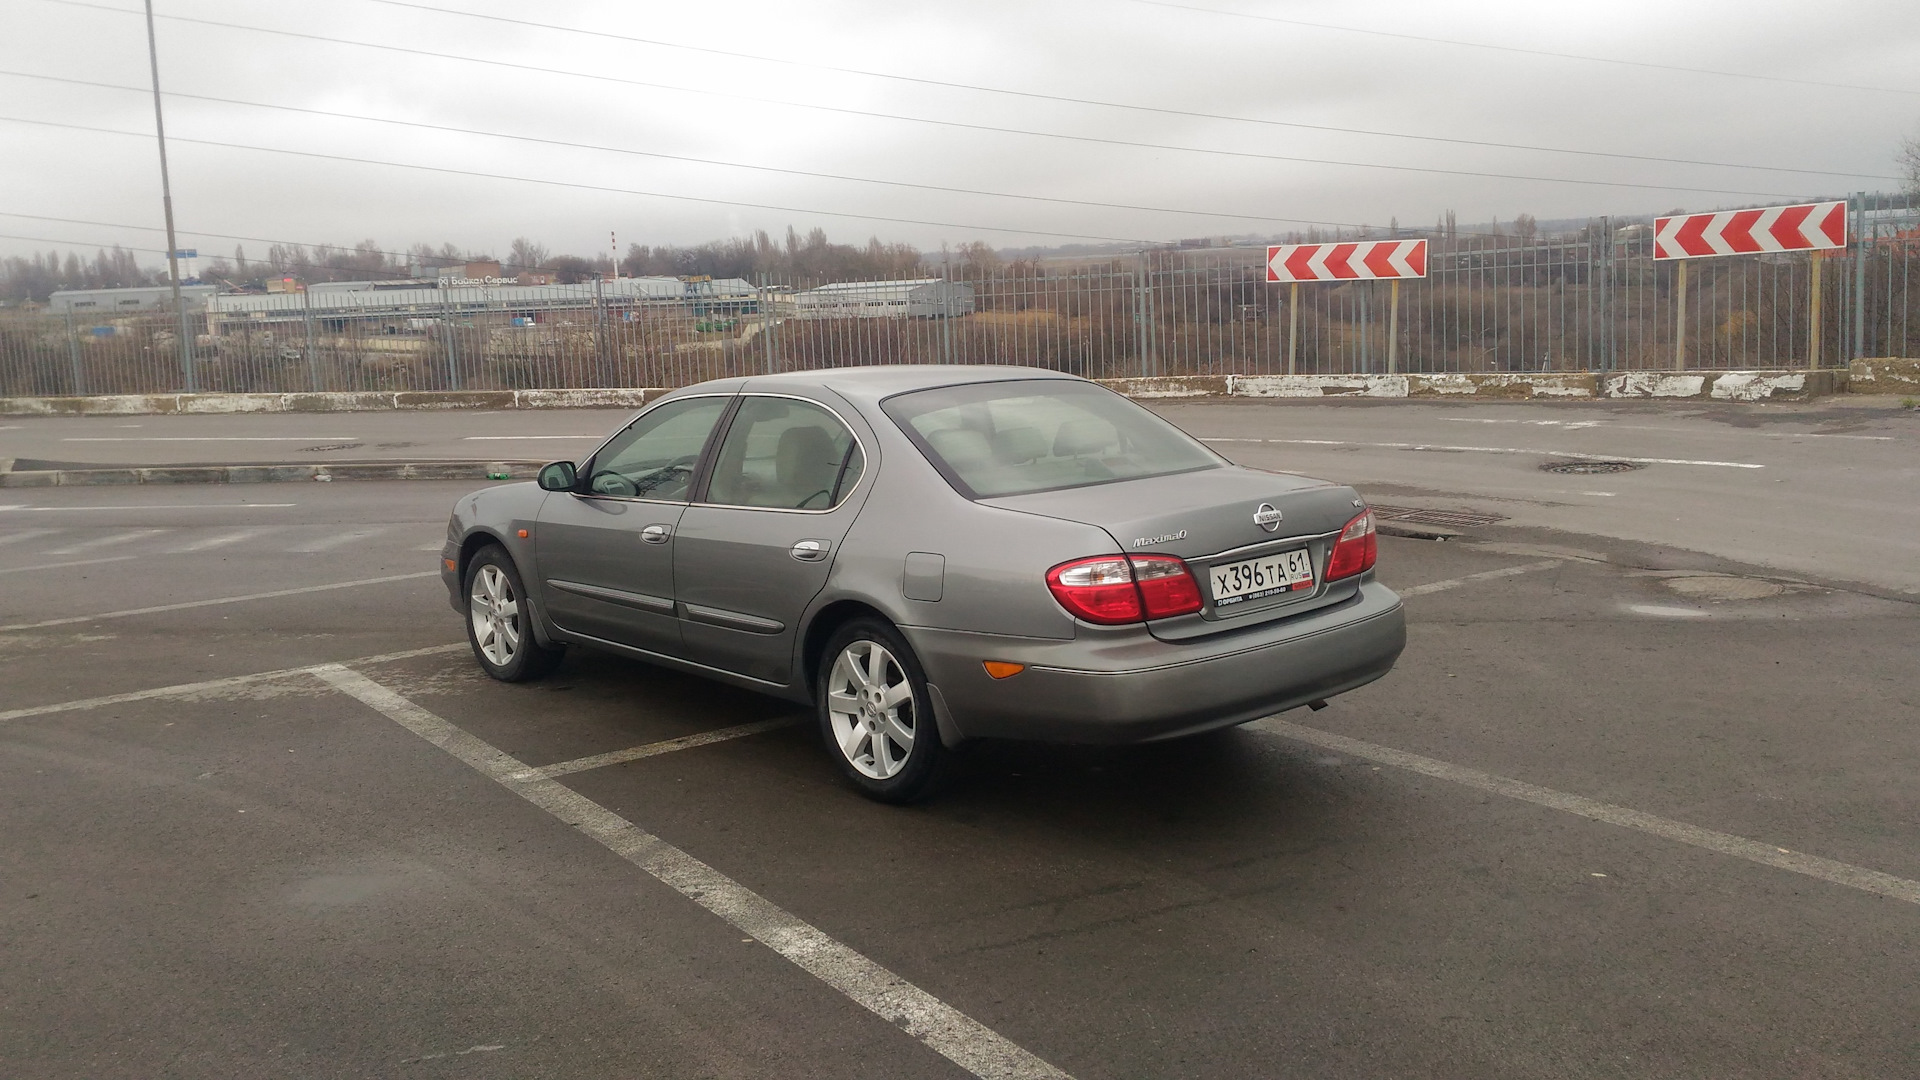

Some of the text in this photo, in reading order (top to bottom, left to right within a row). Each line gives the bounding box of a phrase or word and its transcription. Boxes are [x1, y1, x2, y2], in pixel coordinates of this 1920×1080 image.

[451, 275, 518, 286] Байкал Сервис
[1258, 512, 1281, 522] NISSAN
[1290, 573, 1302, 581] RUS
